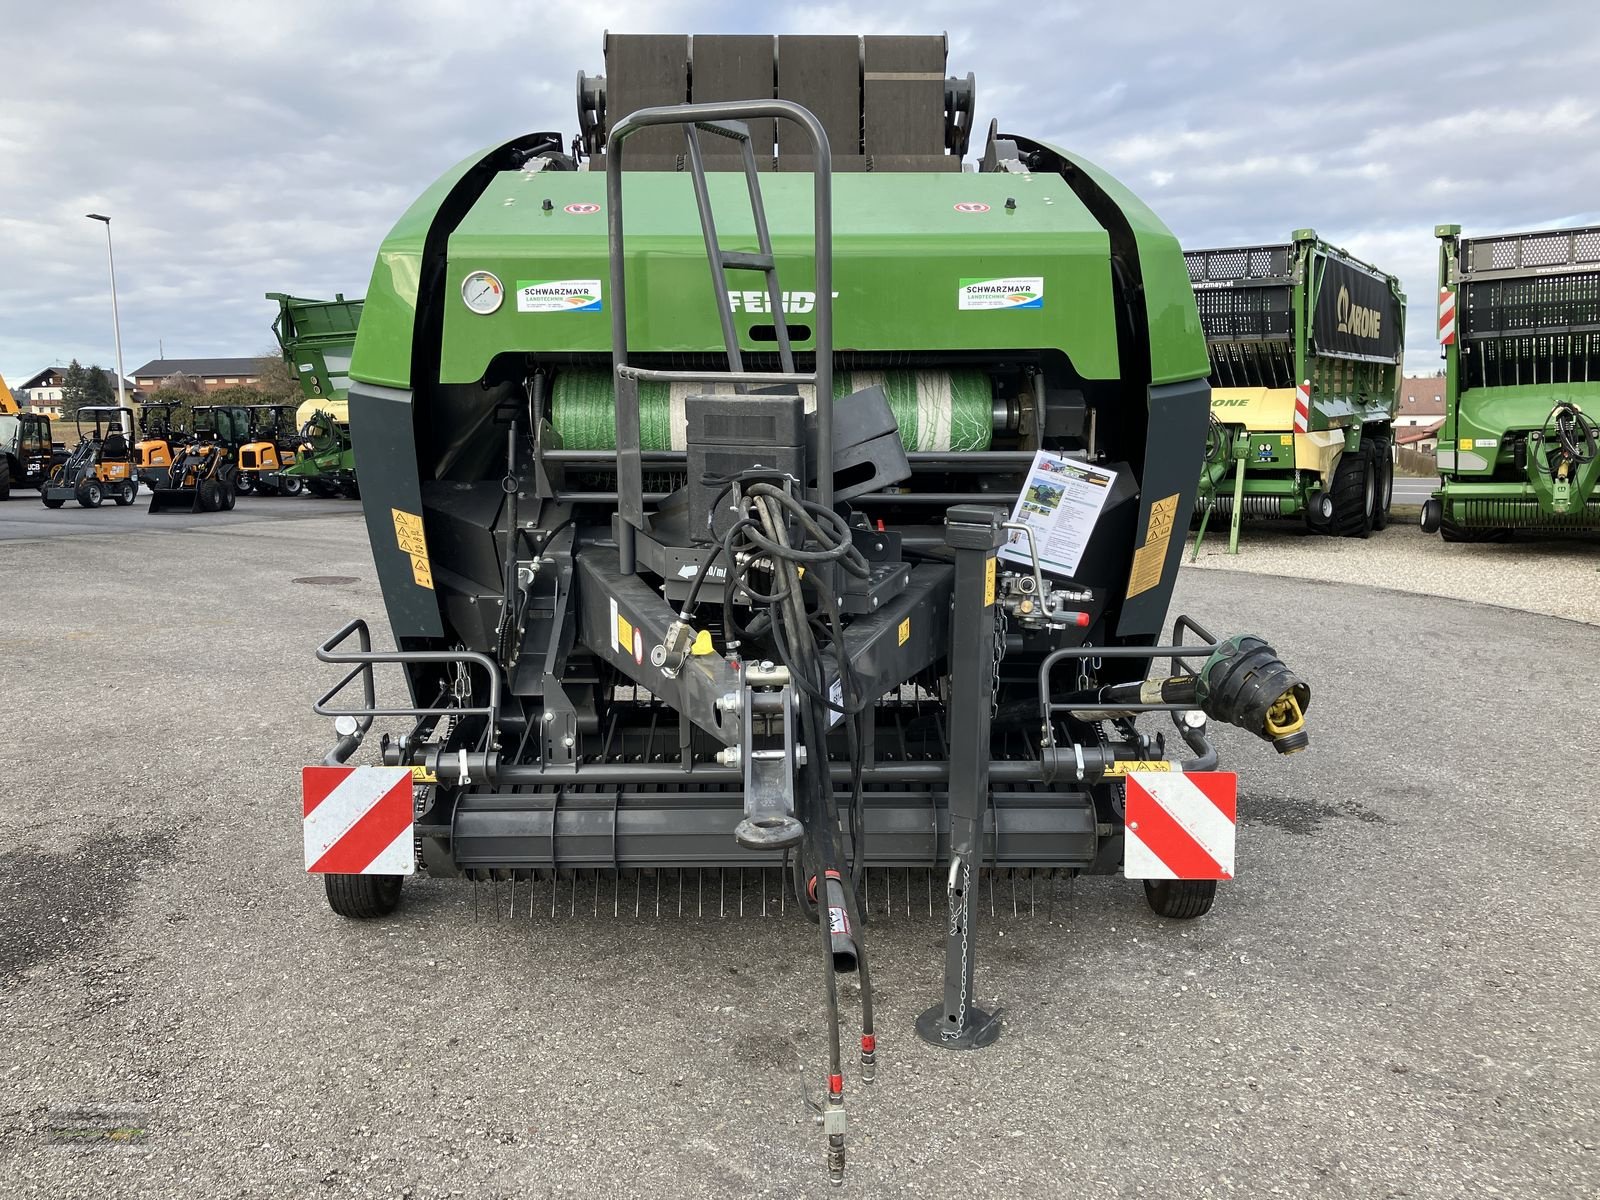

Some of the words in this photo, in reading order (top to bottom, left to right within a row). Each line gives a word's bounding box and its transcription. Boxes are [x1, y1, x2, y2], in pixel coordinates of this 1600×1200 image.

[1193, 280, 1234, 289] warzmayr.at
[524, 288, 590, 296] SCHWARZMAYR
[966, 285, 1031, 293] SCHWARZMAYR
[727, 290, 839, 314] FEND
[1212, 399, 1250, 407] ONE
